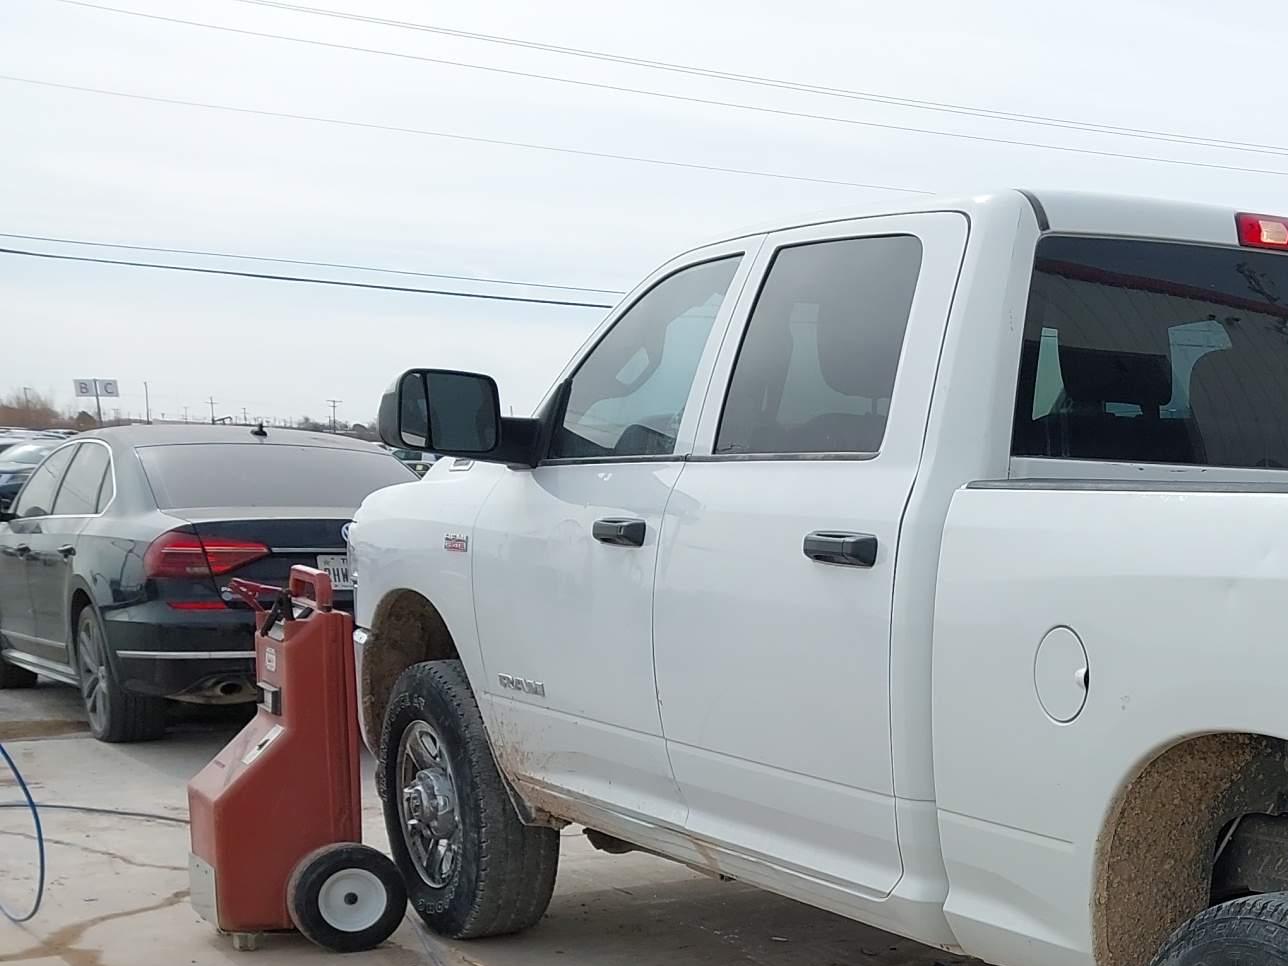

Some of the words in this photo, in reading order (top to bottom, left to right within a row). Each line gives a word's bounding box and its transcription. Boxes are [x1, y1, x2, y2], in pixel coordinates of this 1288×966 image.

[80, 382, 89, 394] B
[104, 382, 114, 394] C
[497, 672, 546, 697] RAM
